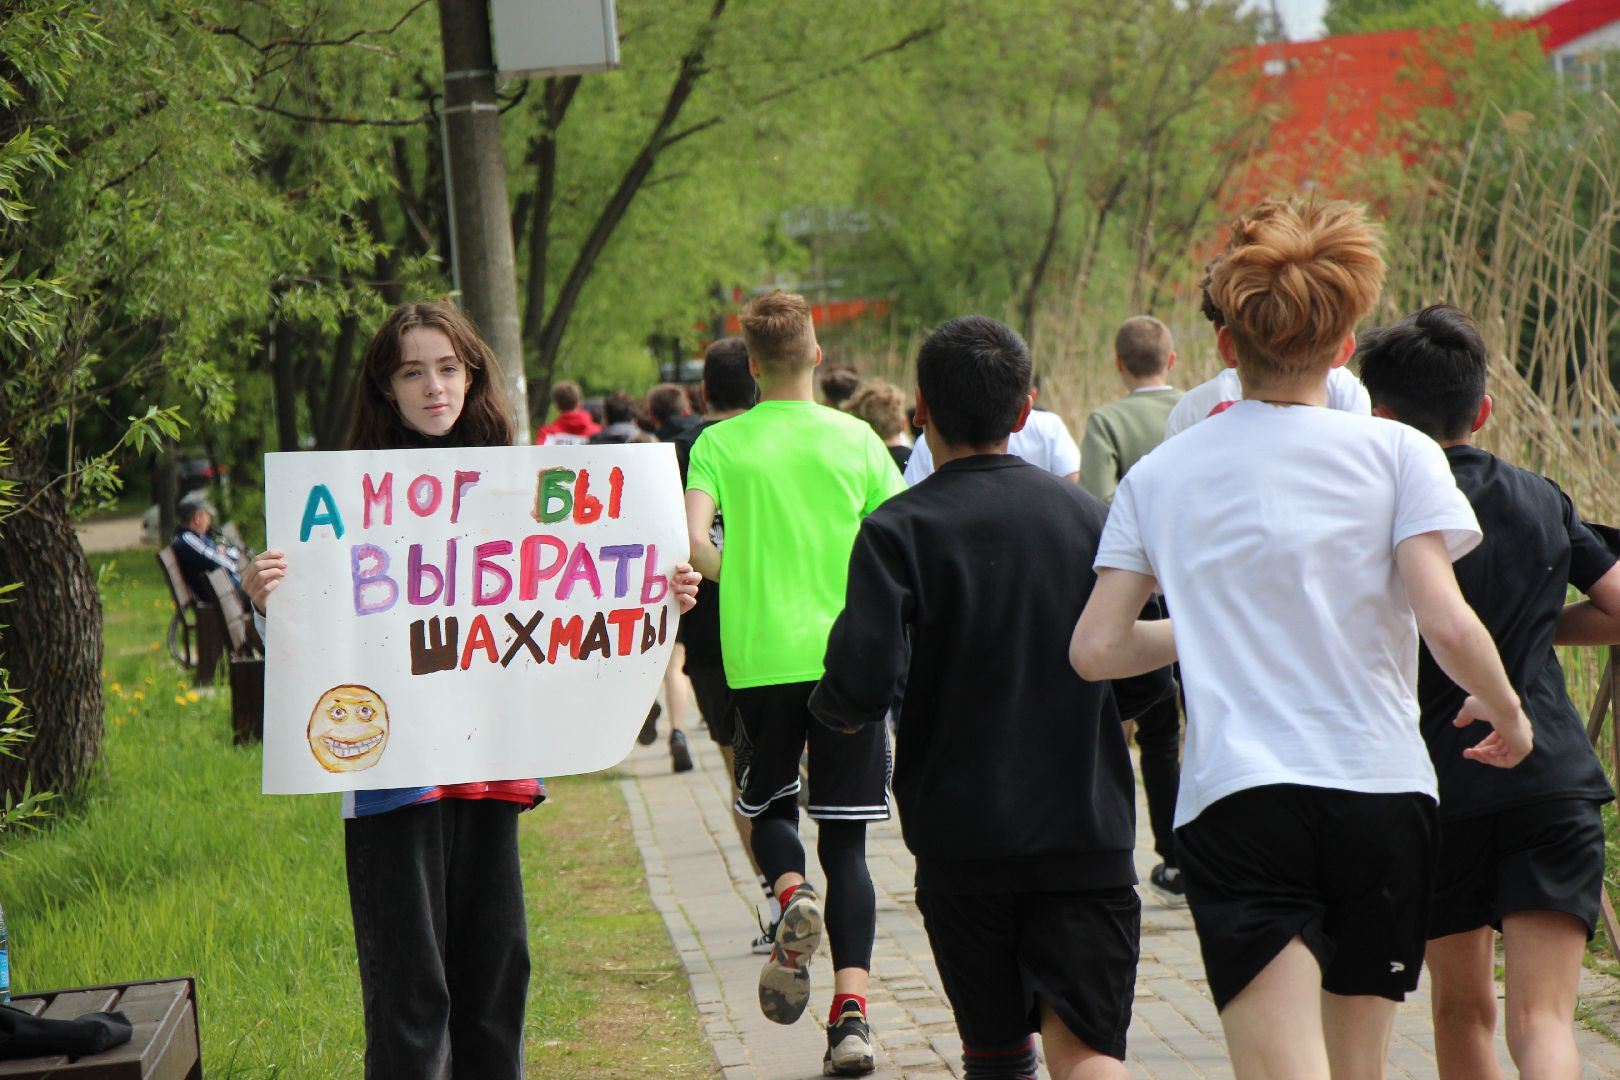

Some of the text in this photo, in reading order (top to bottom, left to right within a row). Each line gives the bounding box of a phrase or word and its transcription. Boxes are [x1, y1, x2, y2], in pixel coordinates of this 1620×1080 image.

[299, 466, 625, 541] А МОГ БЫ
[351, 535, 669, 616] ВЫБРАТЬ
[409, 605, 668, 675] ШАХМАТЫ
